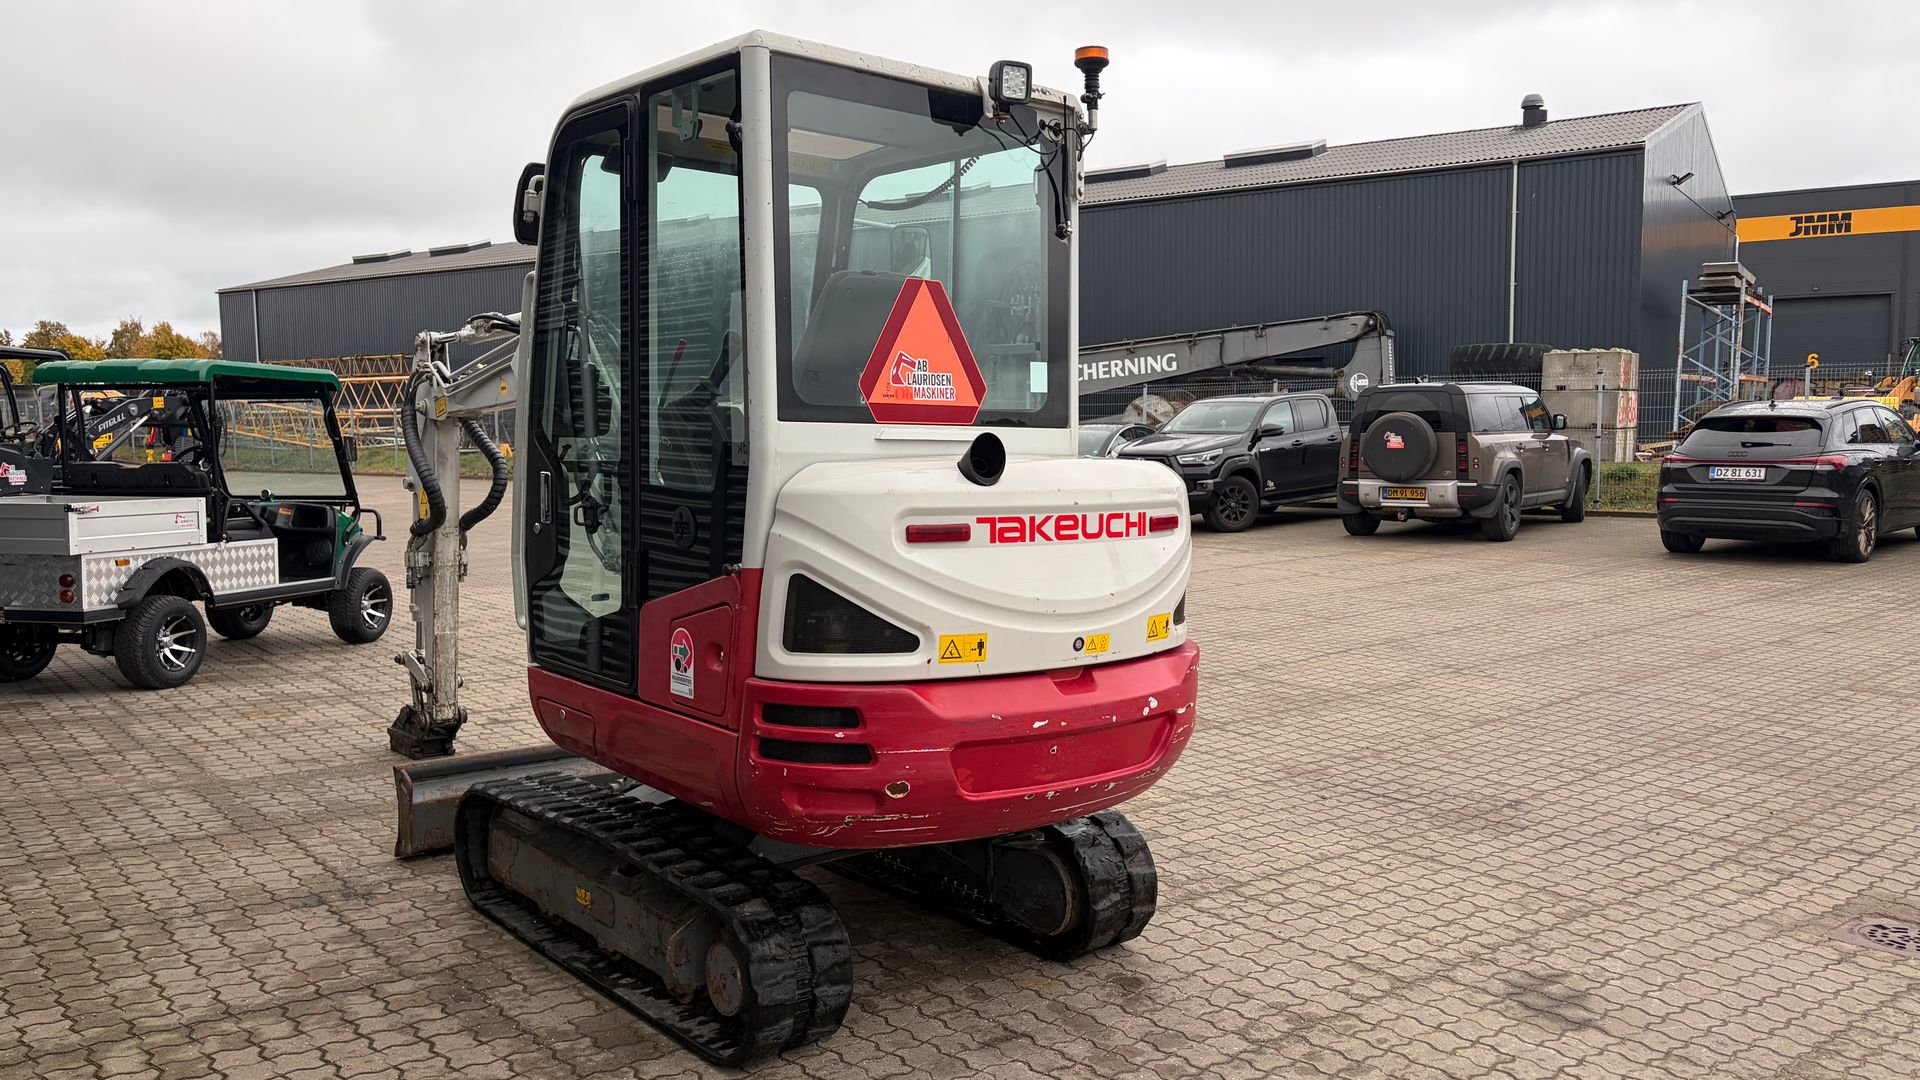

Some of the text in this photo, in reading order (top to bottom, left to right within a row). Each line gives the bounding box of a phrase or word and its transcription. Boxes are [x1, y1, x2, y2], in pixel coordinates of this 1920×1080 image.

[1789, 213, 1852, 237] JMM
[916, 360, 928, 372] AB
[907, 373, 951, 386] LAURIDSEN
[913, 386, 955, 400] MASKINER
[98, 413, 126, 432] PITBULL
[1716, 469, 1762, 478] DZ 81 631
[1400, 489, 1407, 497] 91
[1410, 489, 1424, 497] 956
[976, 512, 1146, 544] TAKEUCHI
